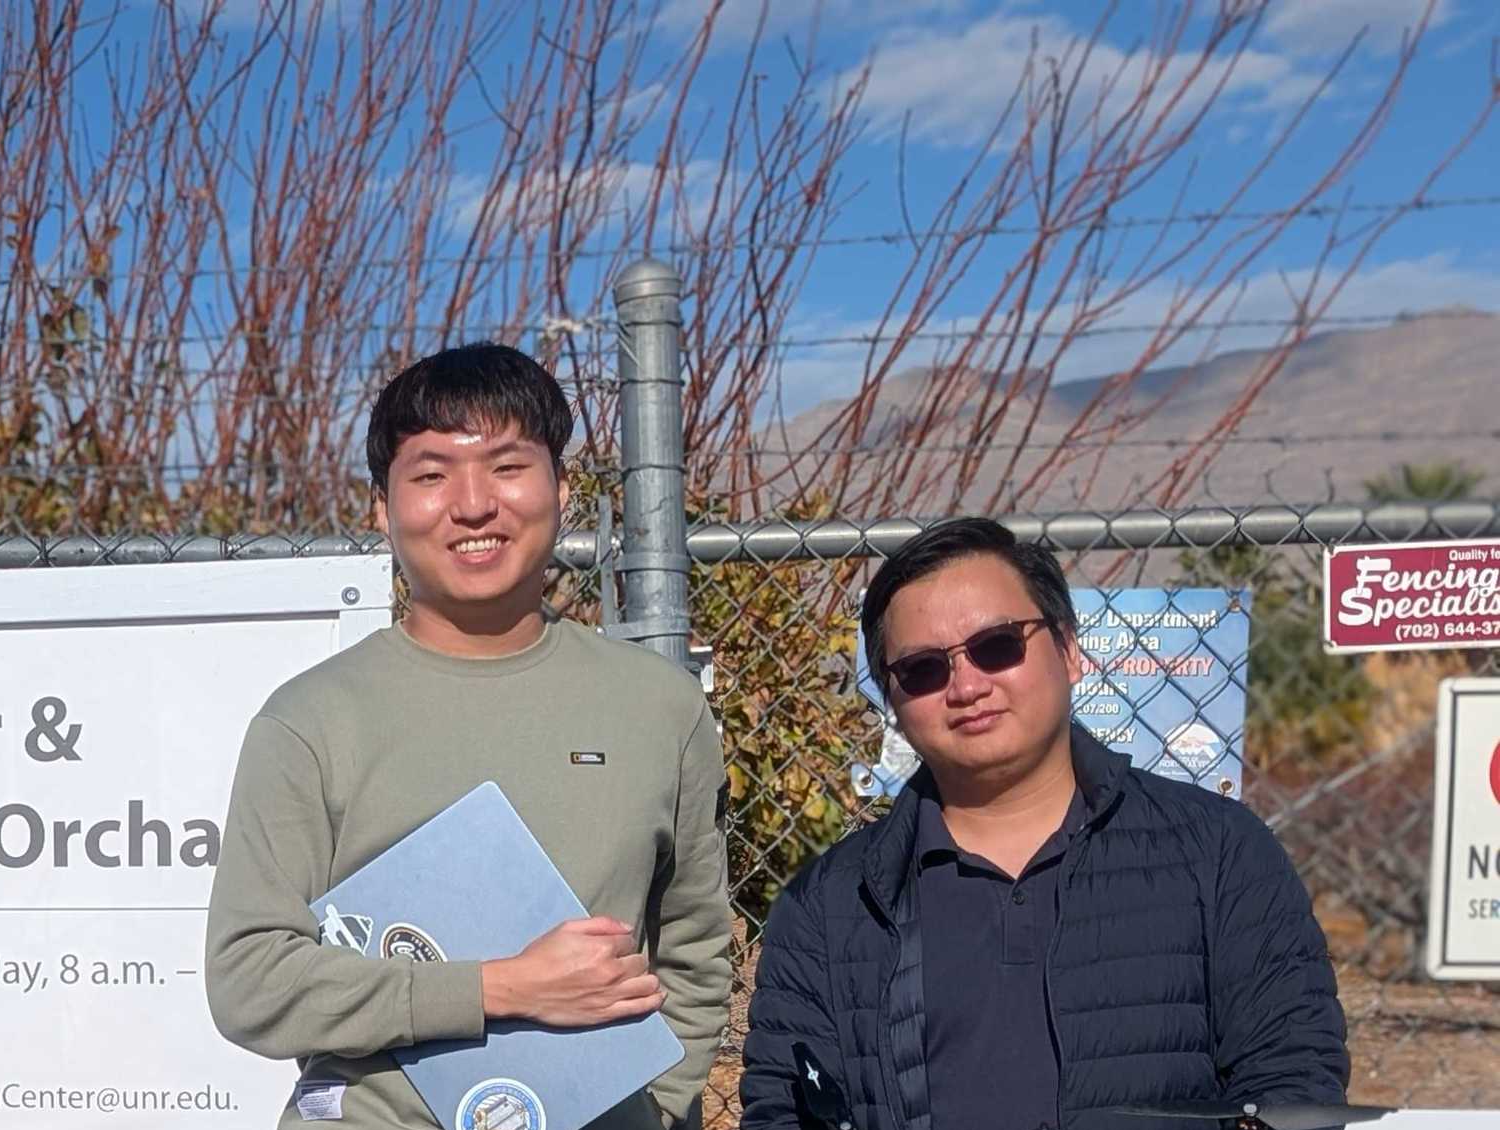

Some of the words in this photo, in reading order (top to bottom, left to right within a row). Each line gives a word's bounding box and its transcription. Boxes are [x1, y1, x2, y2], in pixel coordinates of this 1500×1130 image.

[1449, 549, 1488, 562] Quality
[1356, 555, 1500, 597] Fencing
[1106, 609, 1219, 628] Department
[1116, 632, 1160, 650] Area
[1395, 623, 1439, 641] (702)
[1111, 657, 1214, 676] PROPERTY
[25, 697, 82, 763] &
[60, 954, 79, 984] 8
[92, 962, 164, 985] a.m.
